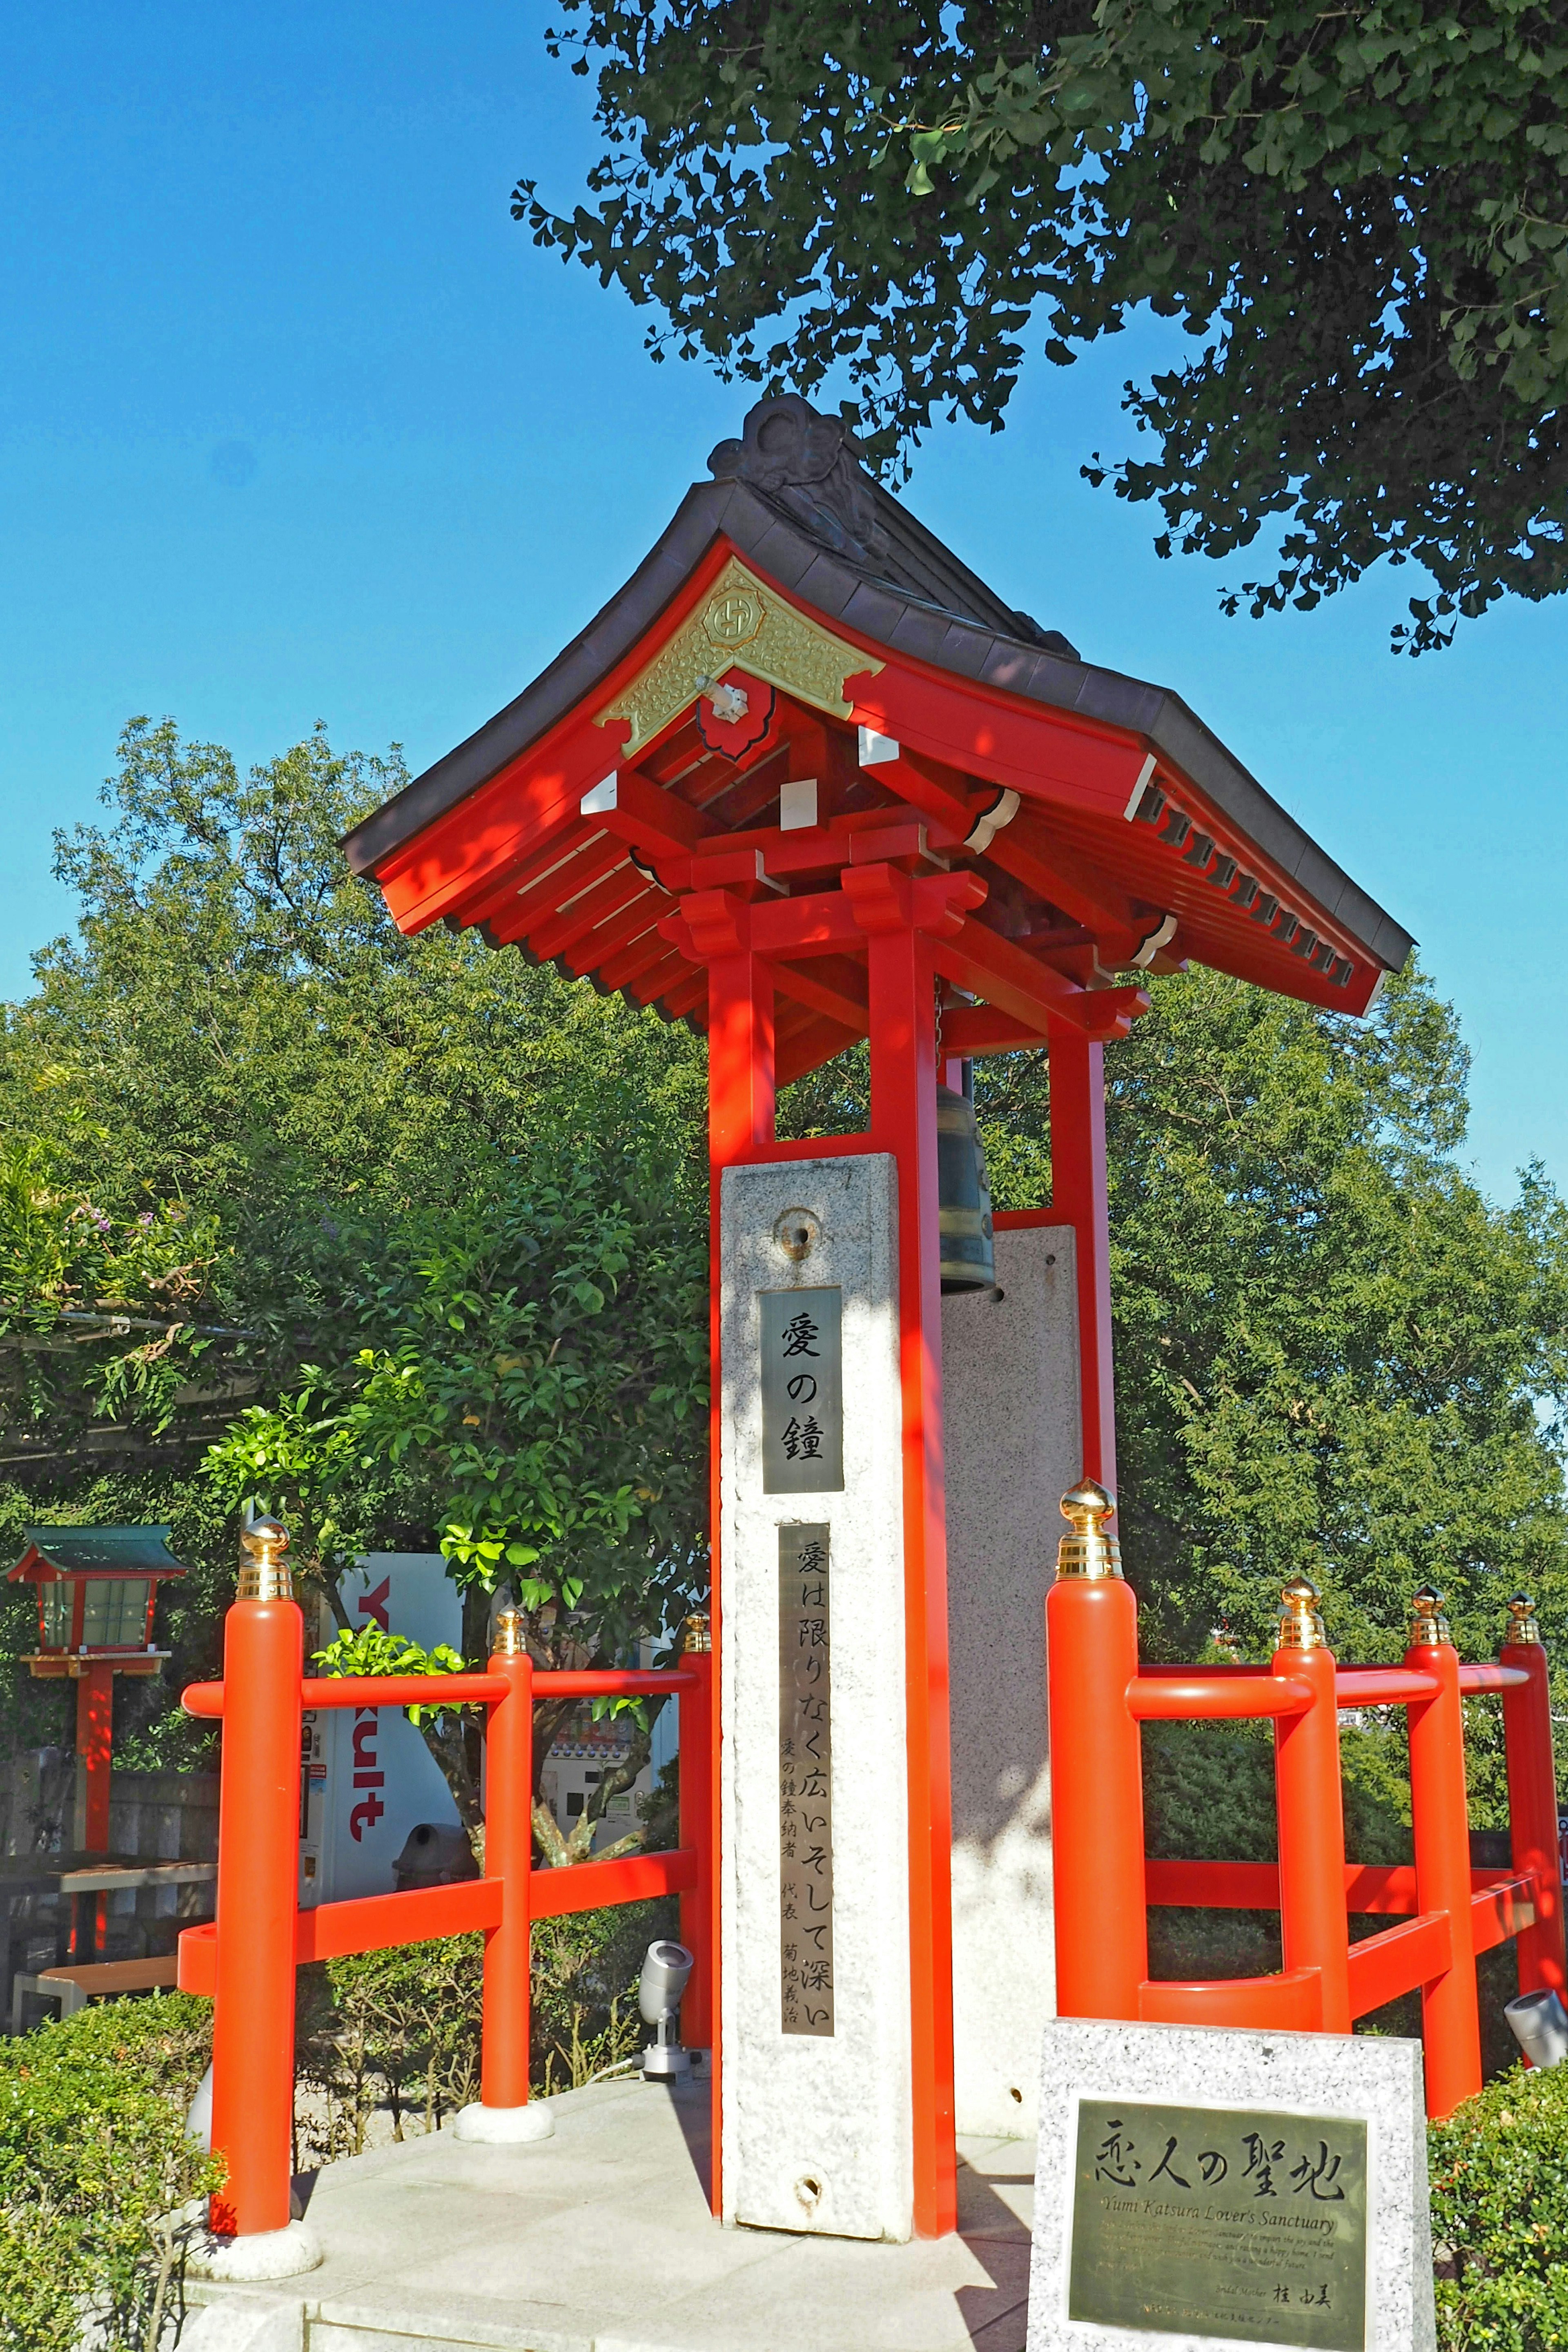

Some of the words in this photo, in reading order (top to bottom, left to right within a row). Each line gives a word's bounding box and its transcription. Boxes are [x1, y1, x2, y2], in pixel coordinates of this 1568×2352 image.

[781, 1312, 824, 1461] 愛の鐘
[350, 1575, 390, 1843] Yult
[780, 1738, 797, 1858] 愛の鐘奉納者
[797, 1541, 833, 2026] 愛は限りなく広いそして深い
[781, 1883, 798, 1920] 代表
[782, 1944, 799, 2024] 菊地義治
[1094, 2120, 1345, 2201] 恋人の聖地
[1102, 2196, 1138, 2213] Yumi
[1143, 2199, 1200, 2218] Katsura
[1204, 2205, 1255, 2224] Lover's
[1258, 2211, 1335, 2236] Sanctuary
[1272, 2283, 1290, 2303] 桂
[1298, 2283, 1332, 2310] 由美
